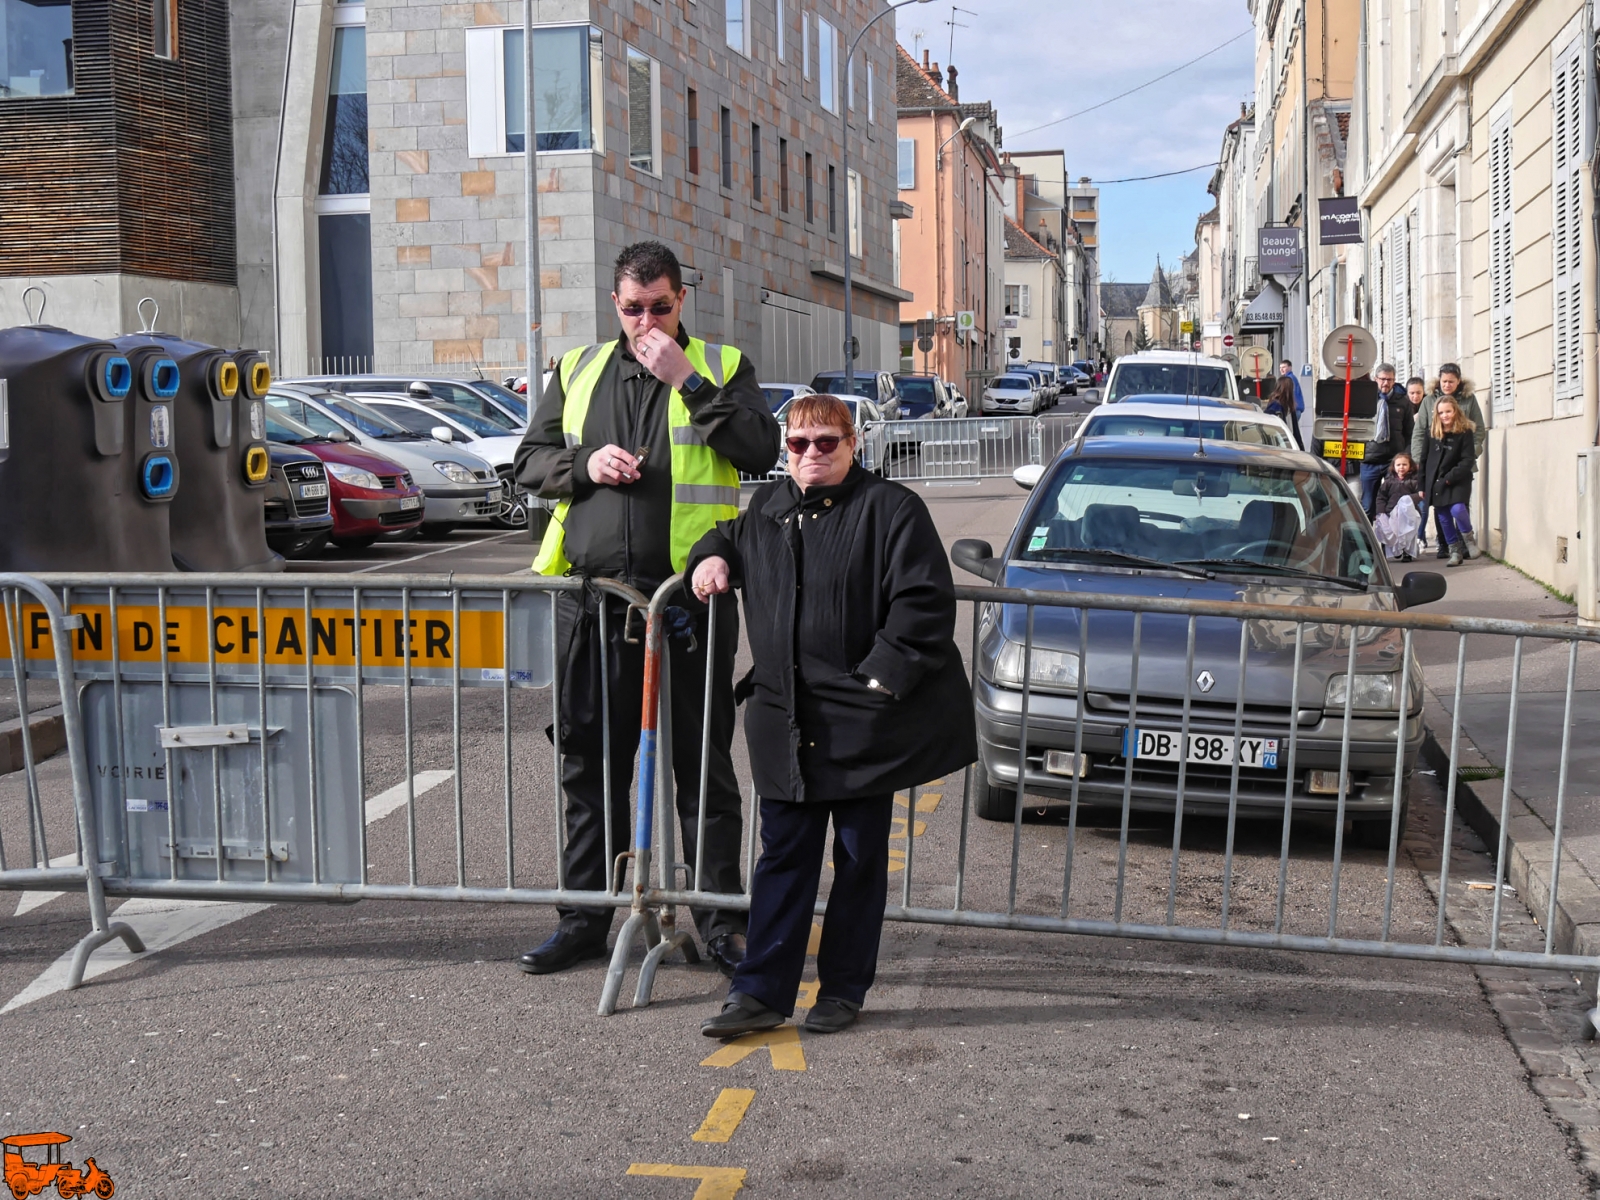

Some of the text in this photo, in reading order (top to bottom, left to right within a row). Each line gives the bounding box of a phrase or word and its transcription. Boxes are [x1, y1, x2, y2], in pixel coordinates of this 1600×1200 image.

[1262, 237, 1295, 246] Beauty
[1261, 247, 1297, 257] Lounge
[1305, 365, 1312, 376] P
[31, 611, 452, 659] FN DE CHANTIER
[1141, 732, 1262, 764] DB-198-XY
[1264, 753, 1277, 766] 70
[97, 764, 166, 780] VOIRIE
